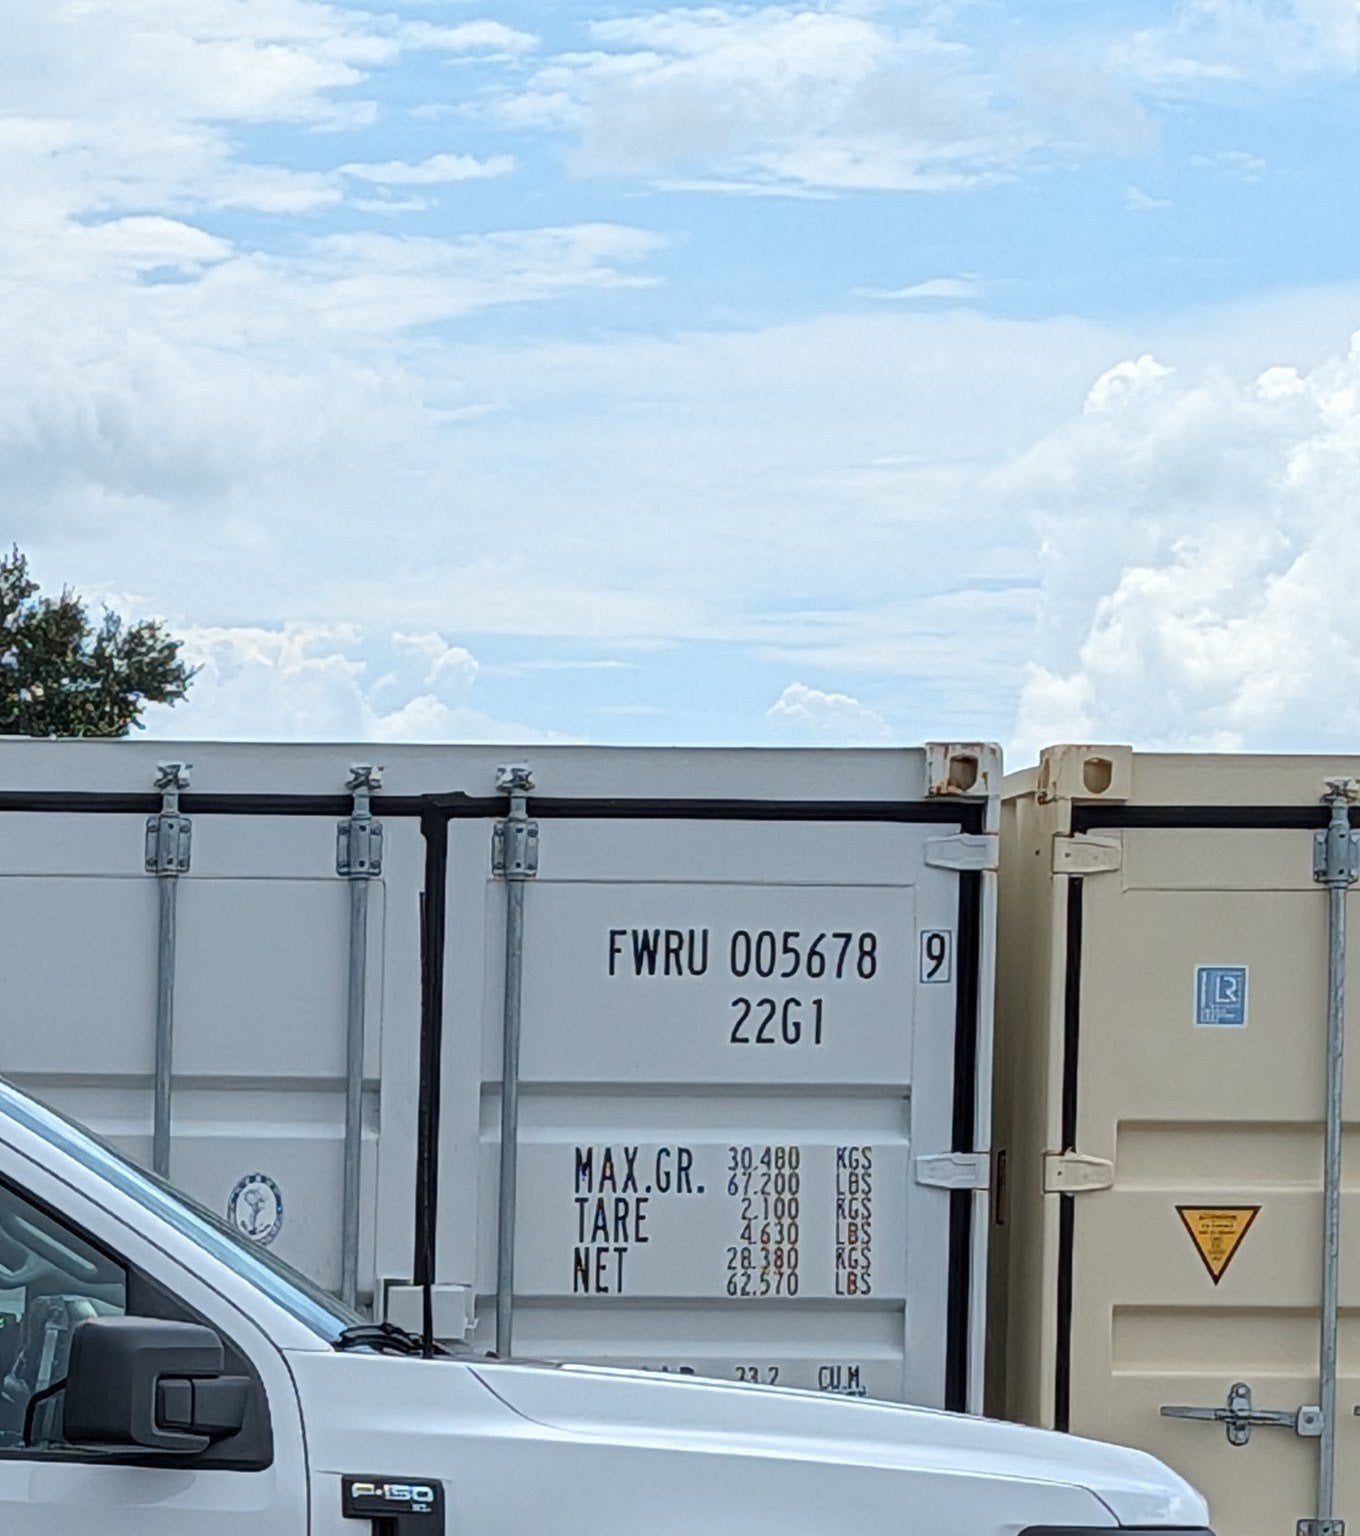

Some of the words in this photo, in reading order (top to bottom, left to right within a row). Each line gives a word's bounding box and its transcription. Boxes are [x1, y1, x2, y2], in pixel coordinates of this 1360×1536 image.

[608, 928, 709, 977] FWRU
[730, 930, 878, 980] 005678
[926, 933, 946, 979] 9
[730, 997, 823, 1045] 22G1
[727, 1146, 800, 1171] 30.480
[836, 1147, 872, 1172] KGS
[727, 1172, 800, 1196] 67.200
[836, 1173, 872, 1197] LBS
[574, 1197, 650, 1244] TARE
[741, 1197, 799, 1220] 2.100
[836, 1198, 872, 1221] KGS
[740, 1221, 799, 1245] 4.630
[836, 1222, 872, 1246] LBS
[574, 1246, 629, 1294] NET
[727, 1246, 799, 1270] 28.380
[836, 1247, 871, 1271] KGS
[726, 1271, 798, 1296] 62.570
[836, 1272, 871, 1297] LBS
[351, 1483, 434, 1503] F-150
